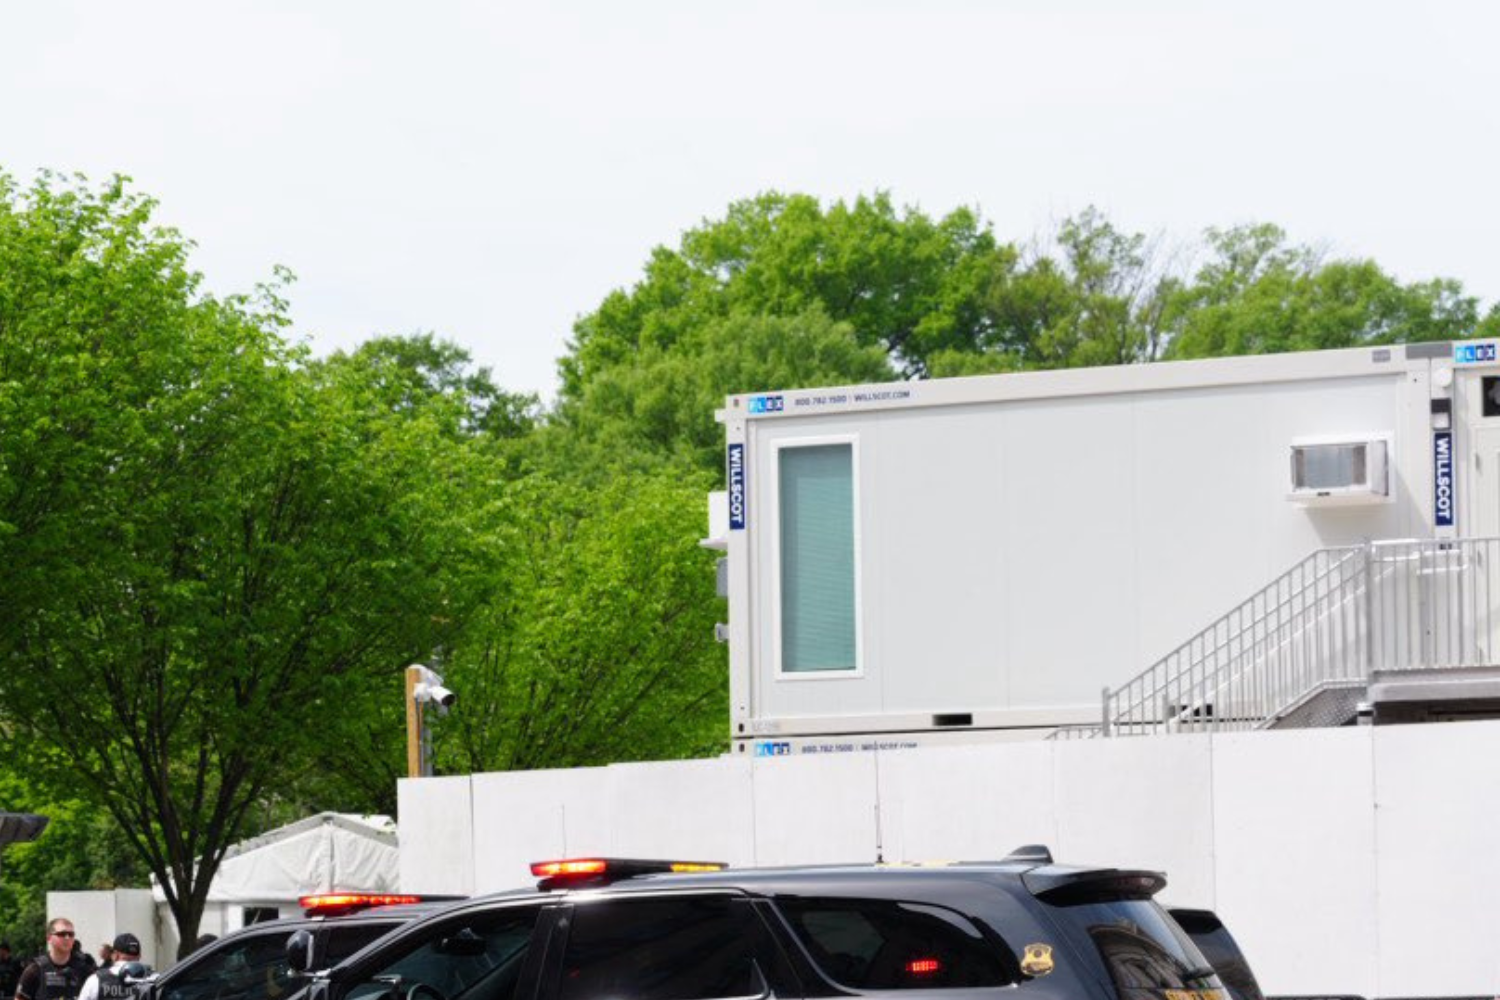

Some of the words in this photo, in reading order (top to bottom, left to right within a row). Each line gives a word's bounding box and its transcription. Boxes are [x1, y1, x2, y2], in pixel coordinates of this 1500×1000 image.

[1456, 345, 1495, 361] FLEX
[730, 447, 743, 524] WILLSCOT
[1437, 437, 1450, 518] WILLSCOT
